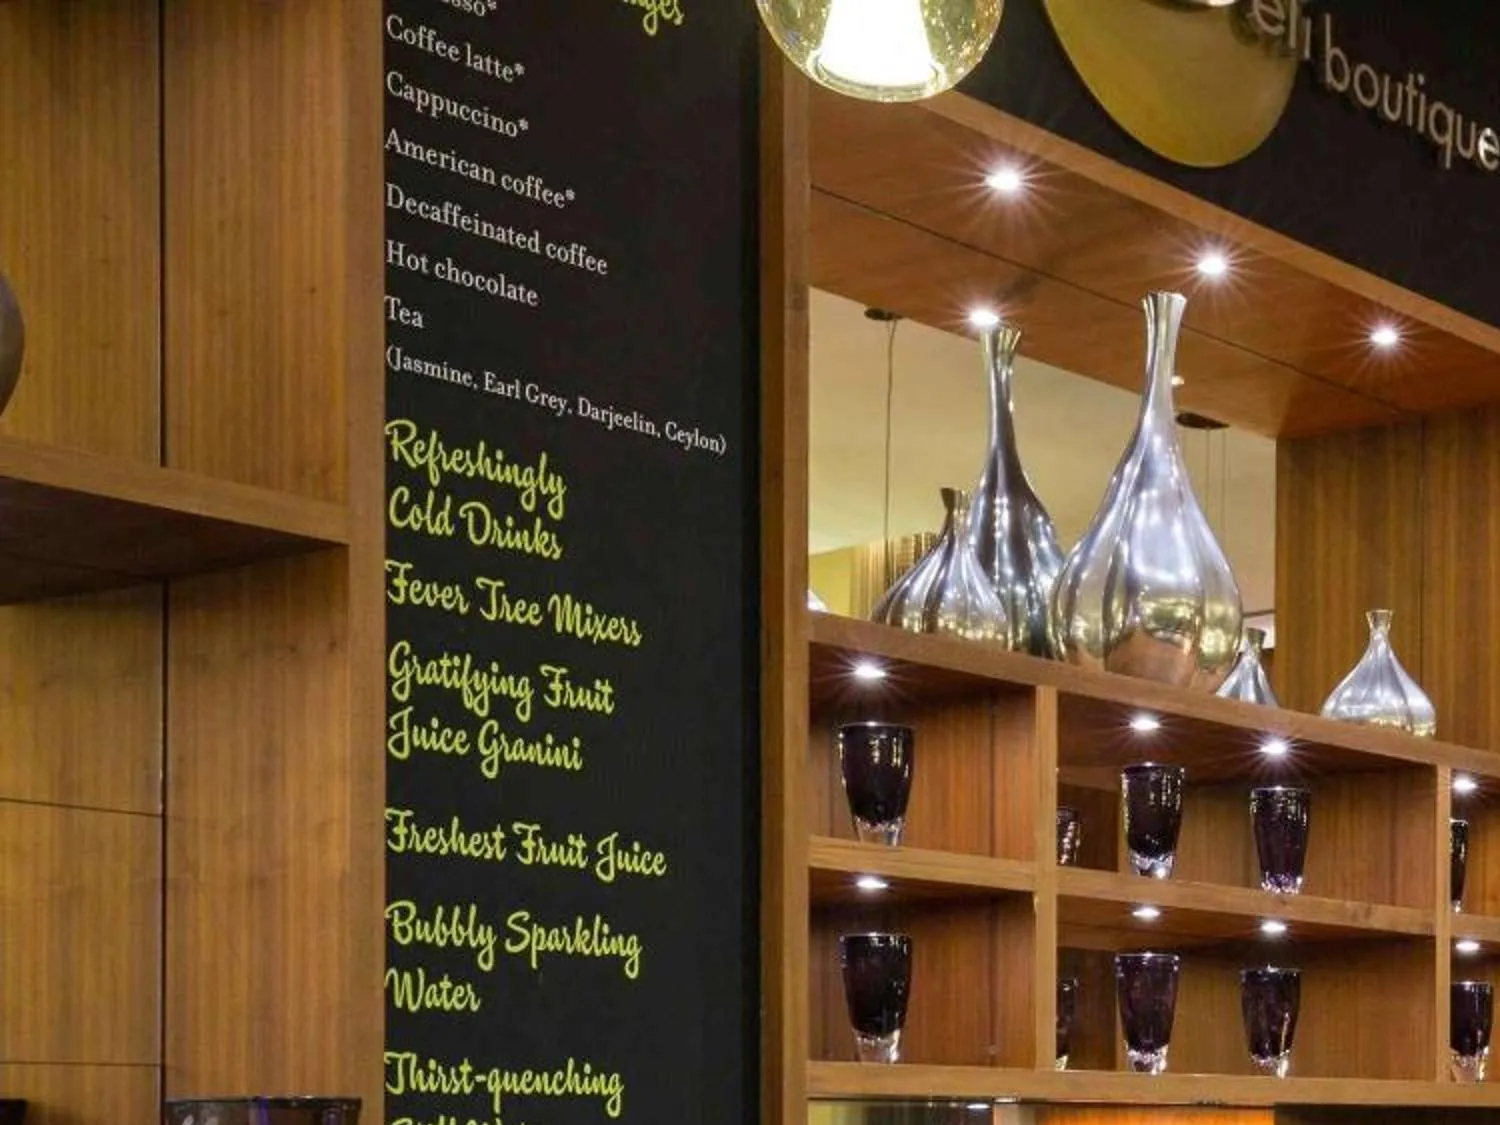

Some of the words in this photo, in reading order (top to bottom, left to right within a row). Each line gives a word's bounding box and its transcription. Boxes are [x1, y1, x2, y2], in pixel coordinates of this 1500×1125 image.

[386, 15, 461, 63] Coffee
[1323, 13, 1500, 171] boutique
[384, 128, 497, 186] American
[385, 183, 540, 255] Decaffeinated
[545, 230, 609, 275] coffee
[386, 240, 430, 275] Hot
[434, 257, 539, 307] chocolate
[384, 295, 425, 330] Tea
[386, 343, 479, 390] (Jasmine,
[484, 370, 522, 402] Earl
[525, 382, 573, 417] Grey,
[664, 420, 727, 456] Ceylon)
[384, 419, 567, 522] Refreshingly
[388, 485, 455, 537] Cold
[459, 502, 563, 560] Drinks
[384, 559, 470, 615] Fever
[475, 576, 543, 627] Tree
[547, 594, 643, 647] Mixers
[388, 641, 534, 723] Gratifying
[540, 664, 615, 715] Fruit
[387, 706, 470, 761] Juice
[477, 719, 583, 780] Granini
[384, 807, 507, 861] Freshest
[512, 822, 588, 867] Fruit
[595, 831, 667, 883] Juice
[384, 900, 497, 972] Bubbly
[505, 910, 643, 979] Sparkling
[384, 967, 481, 1013] Water
[384, 1050, 625, 1118] Thirst-quenching
